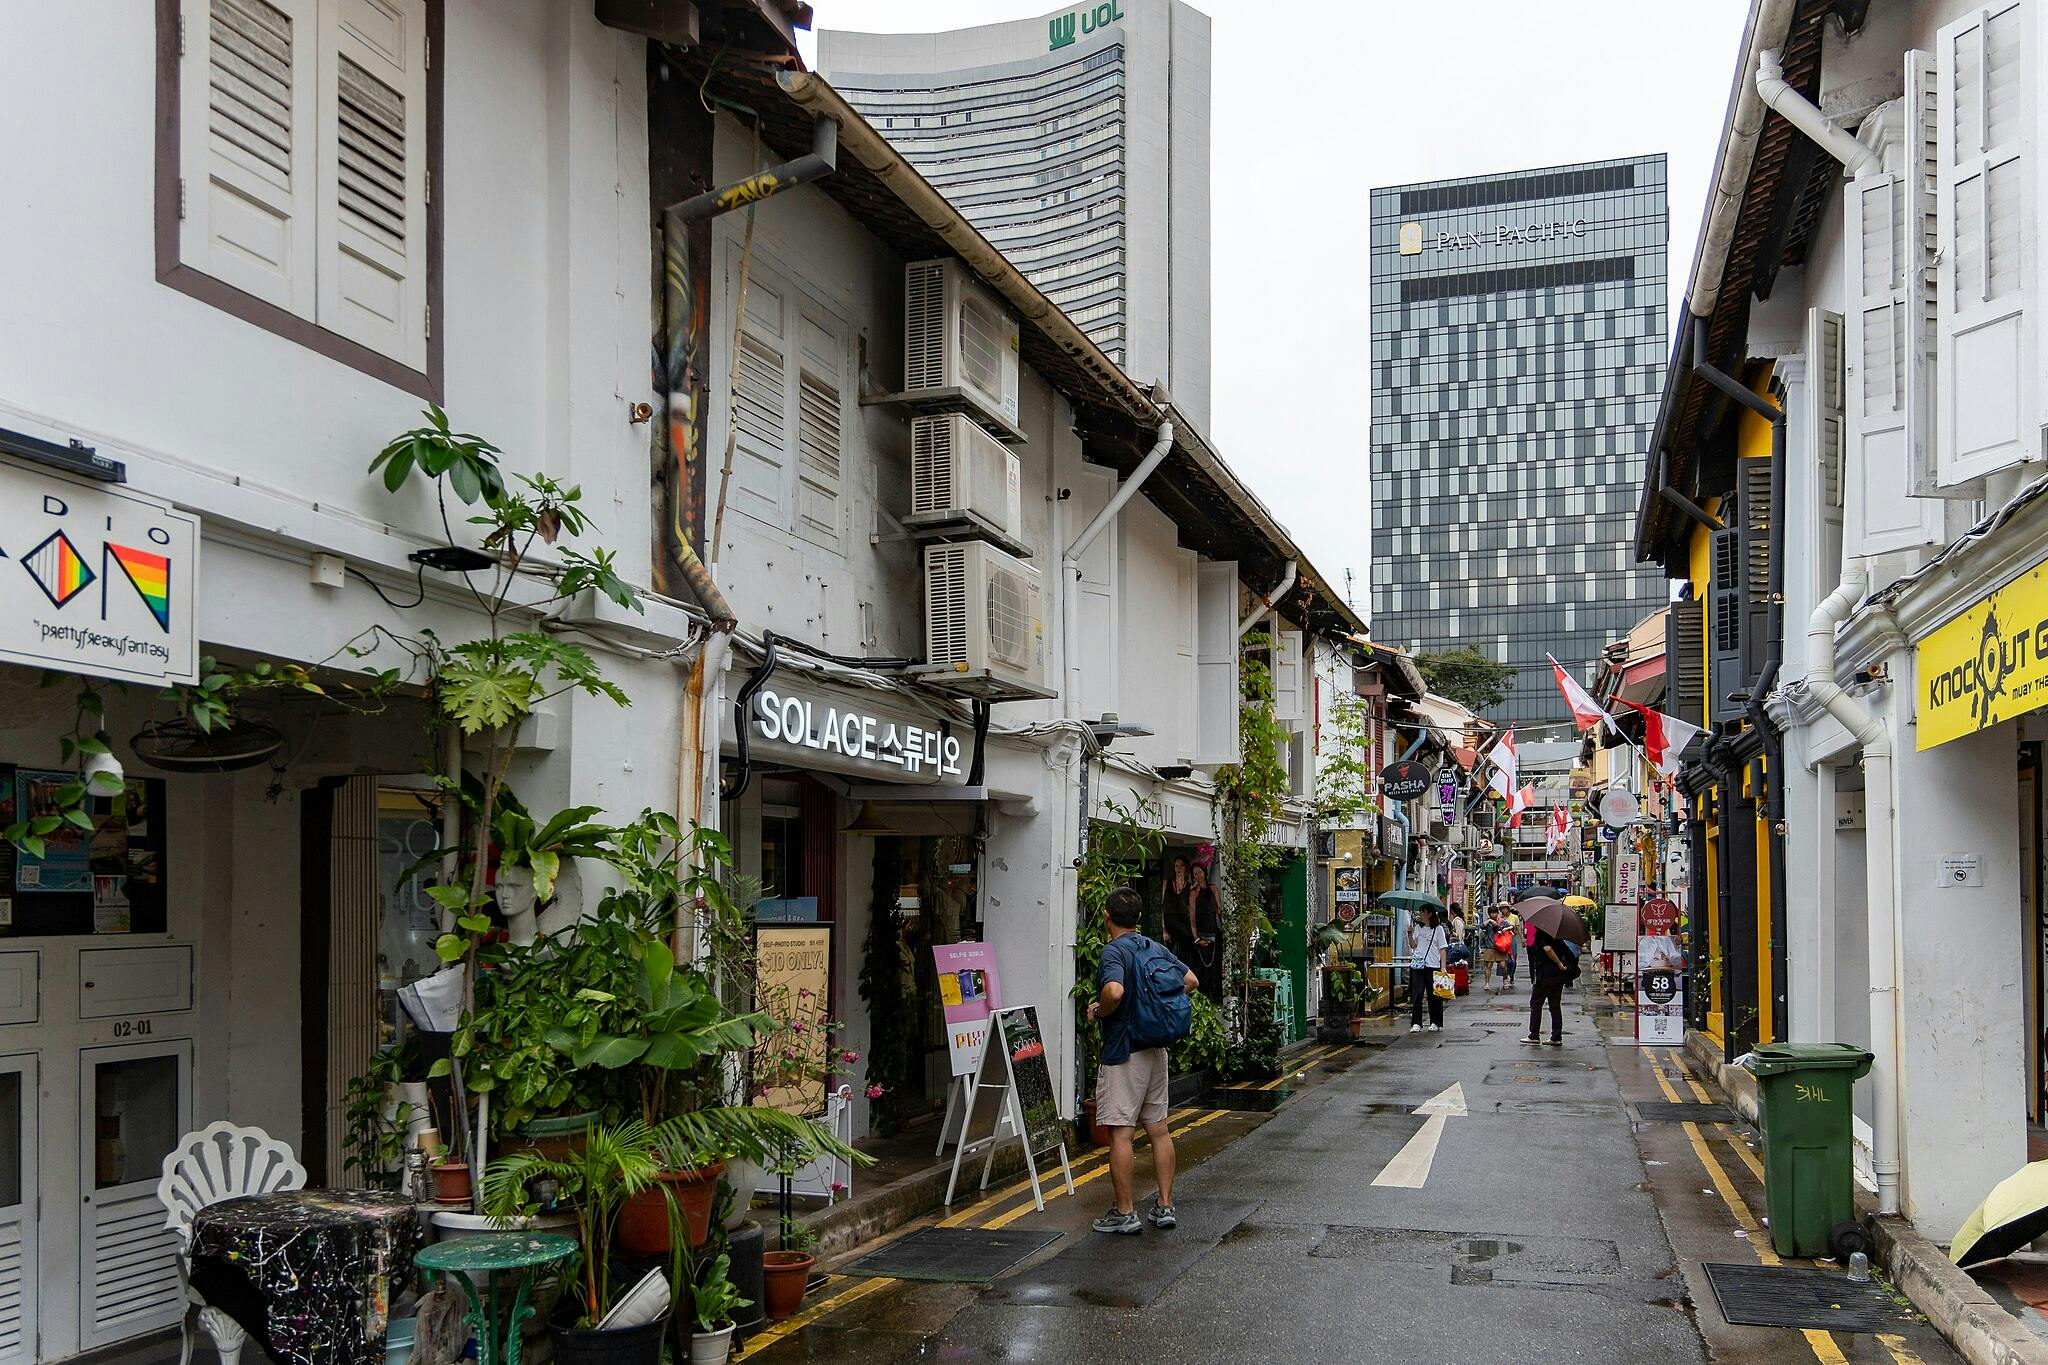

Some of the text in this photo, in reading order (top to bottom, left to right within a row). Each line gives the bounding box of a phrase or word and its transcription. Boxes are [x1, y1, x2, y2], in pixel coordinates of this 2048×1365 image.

[1082, 0, 1124, 34] UOL
[1435, 219, 1587, 252] PAN PACIFIC
[760, 690, 962, 777] SOLACE 스튜디오
[1384, 780, 1426, 792] PASHA
[1619, 862, 1628, 894] Studio
[763, 941, 790, 953] SELF-PHOTO
[790, 940, 805, 951] STUDIO
[763, 951, 824, 974] $10 ONLY!
[1652, 978, 1669, 990] 58
[114, 1019, 152, 1036] 02-01
